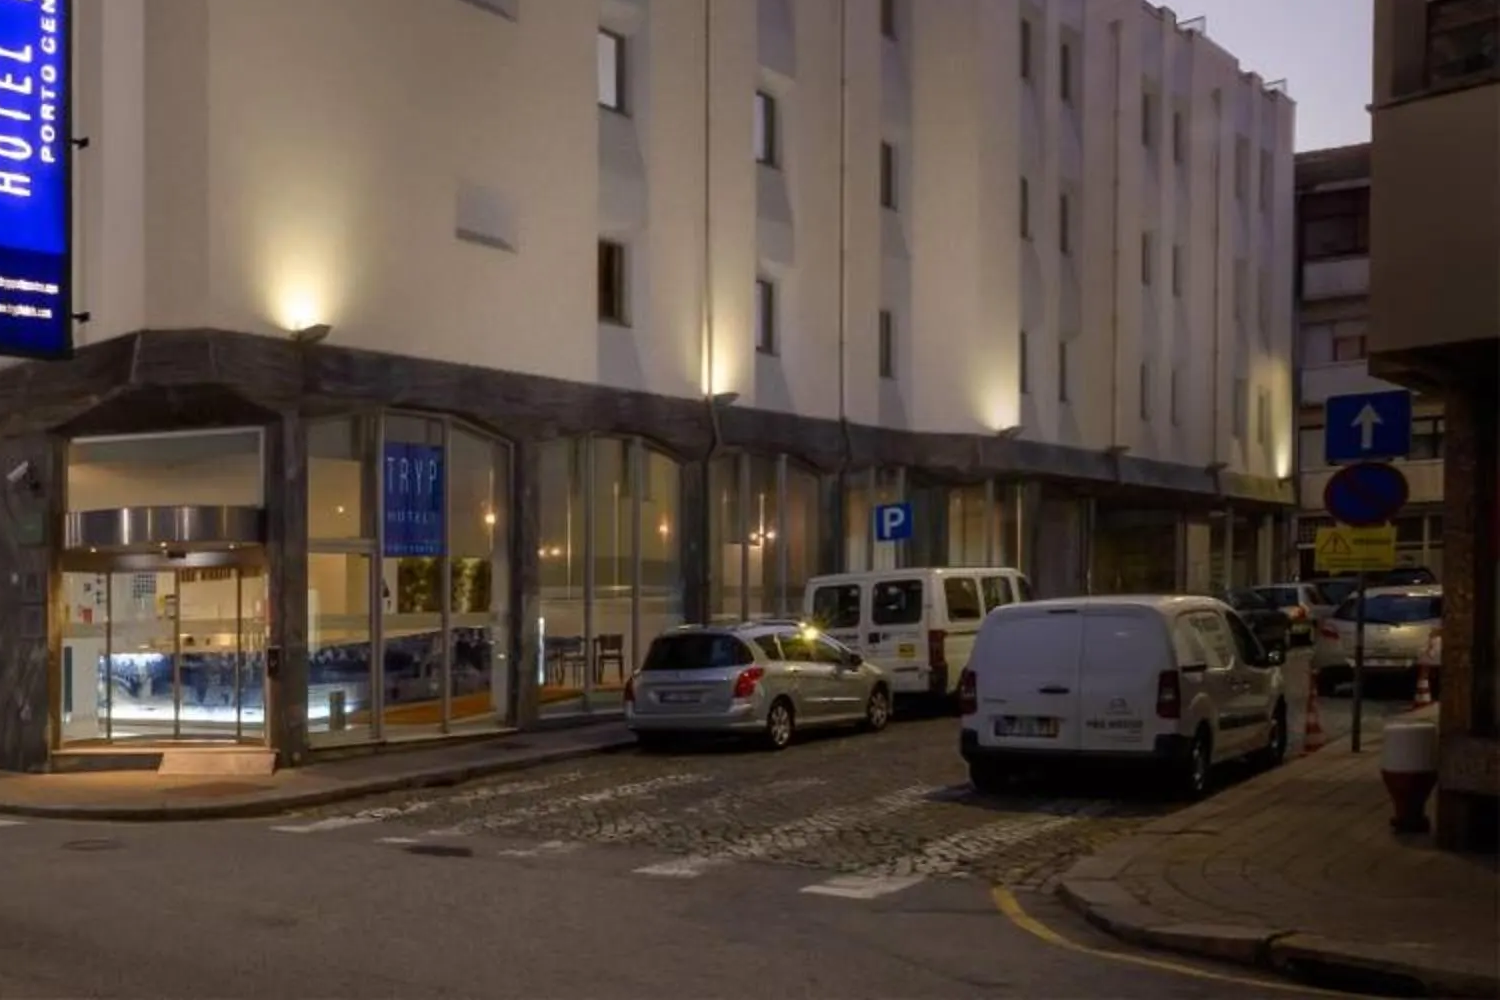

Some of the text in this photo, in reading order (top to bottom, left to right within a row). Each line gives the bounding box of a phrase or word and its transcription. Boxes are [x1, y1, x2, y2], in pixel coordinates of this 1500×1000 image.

[40, 65, 56, 163] PORTO
[386, 456, 437, 495] TRYP
[882, 507, 905, 538] P
